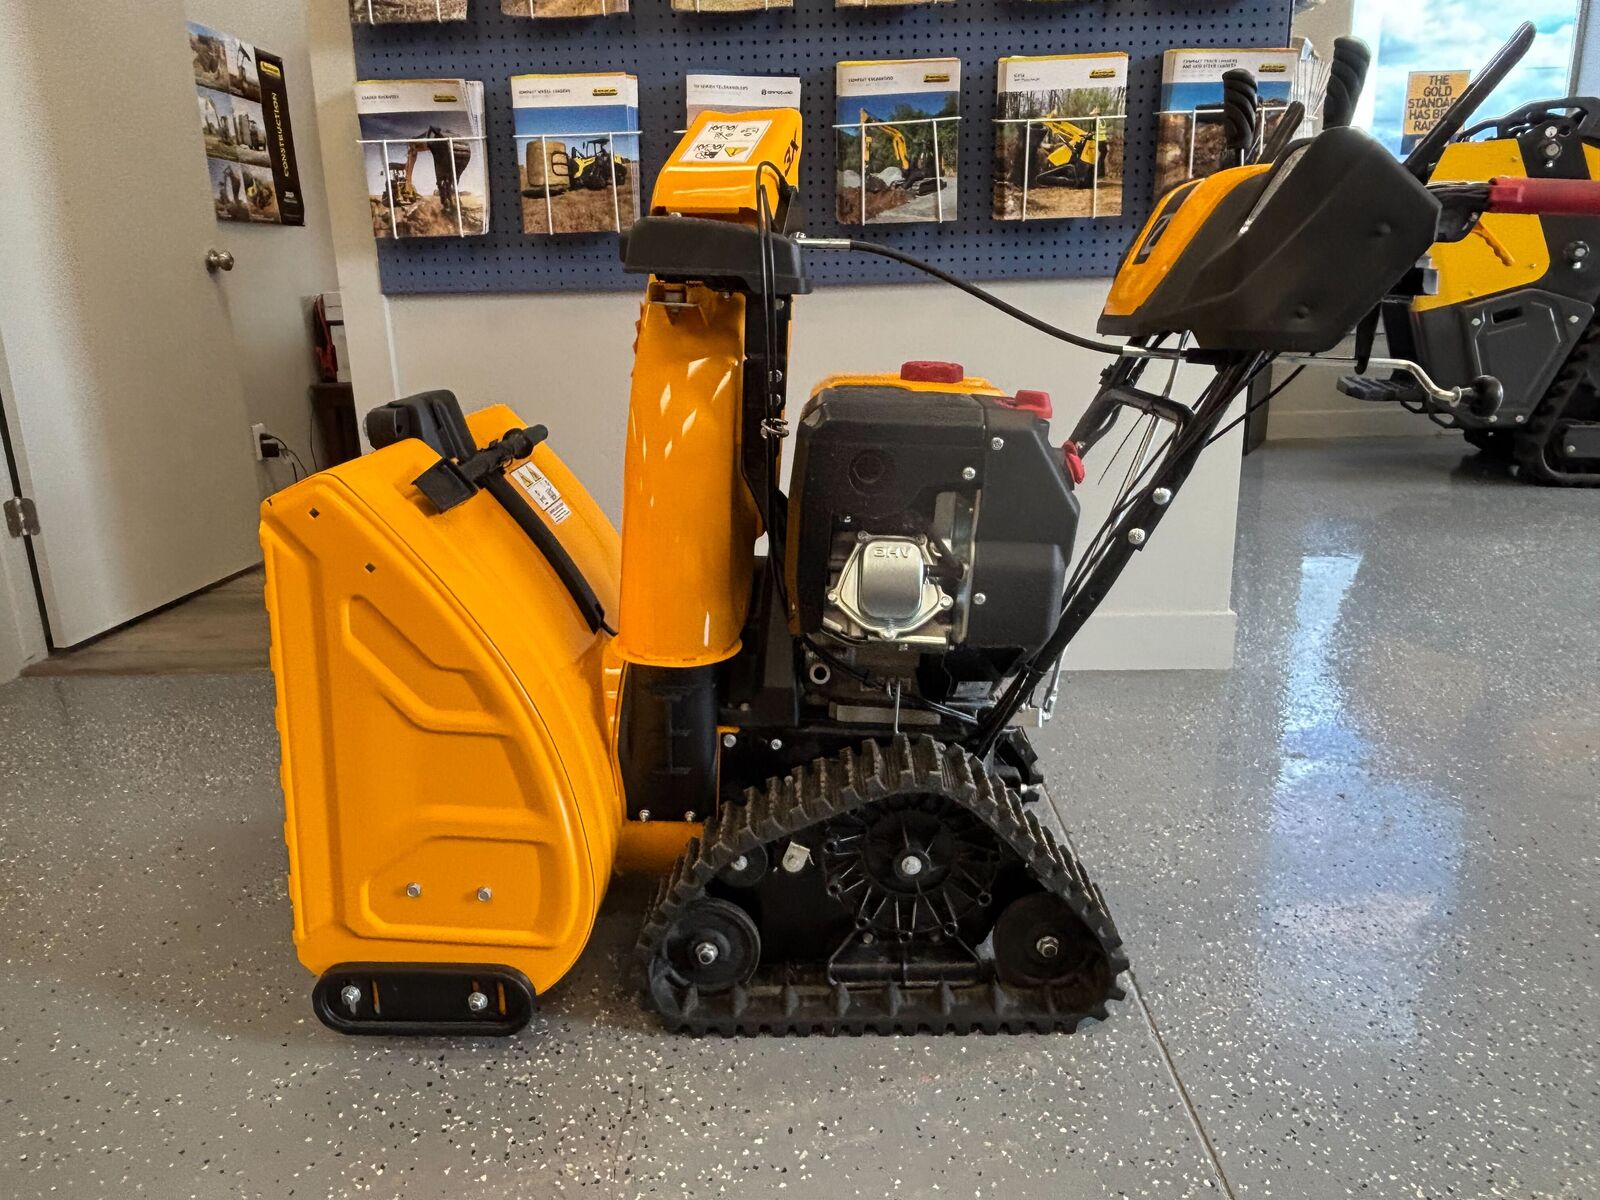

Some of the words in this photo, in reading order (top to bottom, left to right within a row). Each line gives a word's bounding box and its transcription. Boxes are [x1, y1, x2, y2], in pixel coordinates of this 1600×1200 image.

[1429, 74, 1450, 85] THE
[1424, 86, 1453, 97] GOLD
[1409, 109, 1431, 120] HAS
